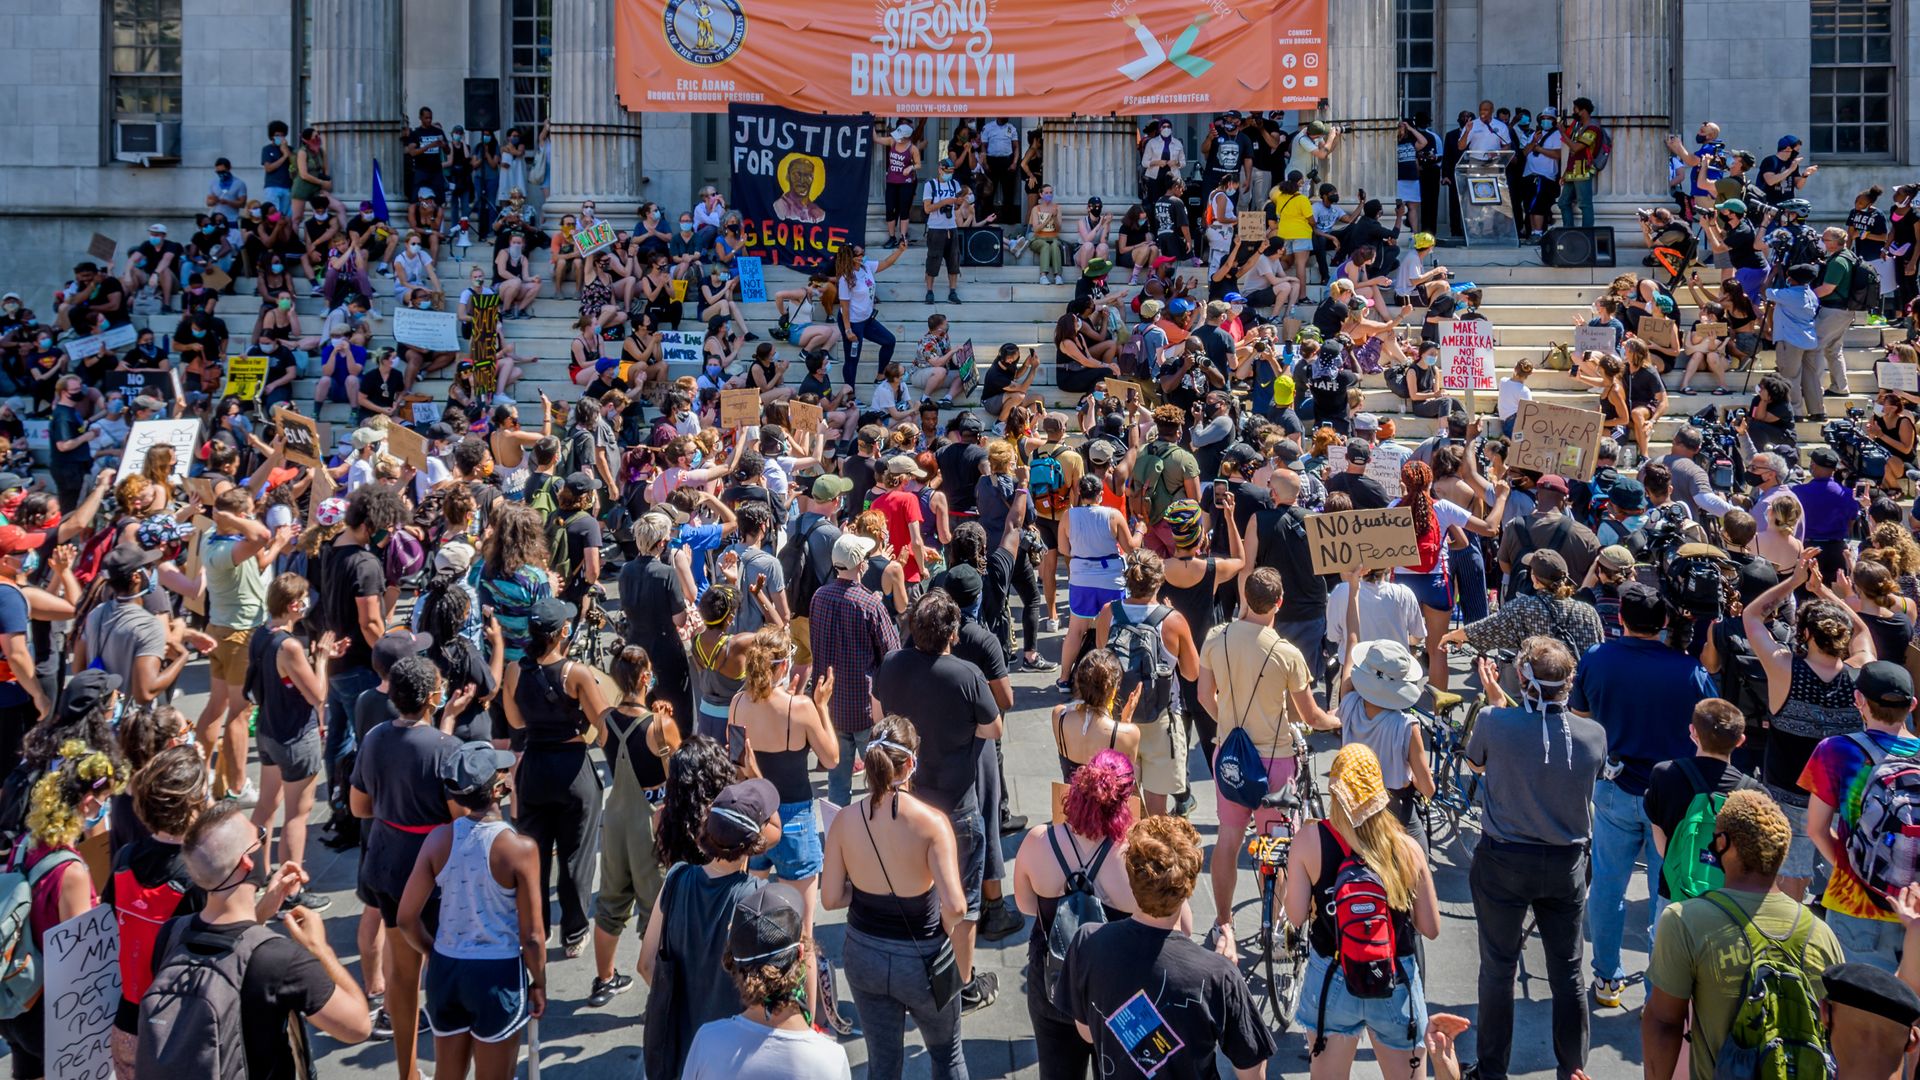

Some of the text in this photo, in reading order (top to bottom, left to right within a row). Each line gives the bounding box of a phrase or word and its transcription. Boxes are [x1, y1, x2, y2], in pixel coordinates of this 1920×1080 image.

[869, 0, 993, 58] STRONG
[666, 12, 744, 63] SEAL OF THE CITY OF BROOKLYN
[851, 53, 1015, 97] BROOKLYN
[676, 79, 736, 92] ERIC ADAMS
[647, 90, 764, 102] BROOKLYN BOROUGH PRESIDENT
[896, 103, 968, 112] BROOKLYN-USA.ORG
[735, 115, 870, 158] JUSTICE
[734, 146, 774, 176] FOR
[889, 152, 906, 161] NEW
[889, 159, 905, 167] YORK
[742, 218, 849, 253] GEORGE
[744, 279, 761, 288] NOT
[1453, 322, 1478, 334] MAKE
[1643, 320, 1673, 333] BLM
[1441, 335, 1493, 349] AMERIKKKA
[663, 348, 698, 360] MATTER
[1459, 348, 1475, 357] NOT
[1453, 355, 1484, 367] RACIST
[1450, 366, 1485, 376] FOR THE
[127, 373, 145, 385] NO
[1443, 376, 1493, 388] FIRST TIME
[1521, 403, 1597, 443] POWER
[283, 427, 314, 444] BLM
[1315, 515, 1348, 539] NO
[1320, 541, 1418, 568] NO Peace
[50, 910, 114, 962] BLAC
[52, 972, 122, 1020] DEFU
[68, 1002, 117, 1035] POL
[52, 1033, 113, 1078] PEAC
